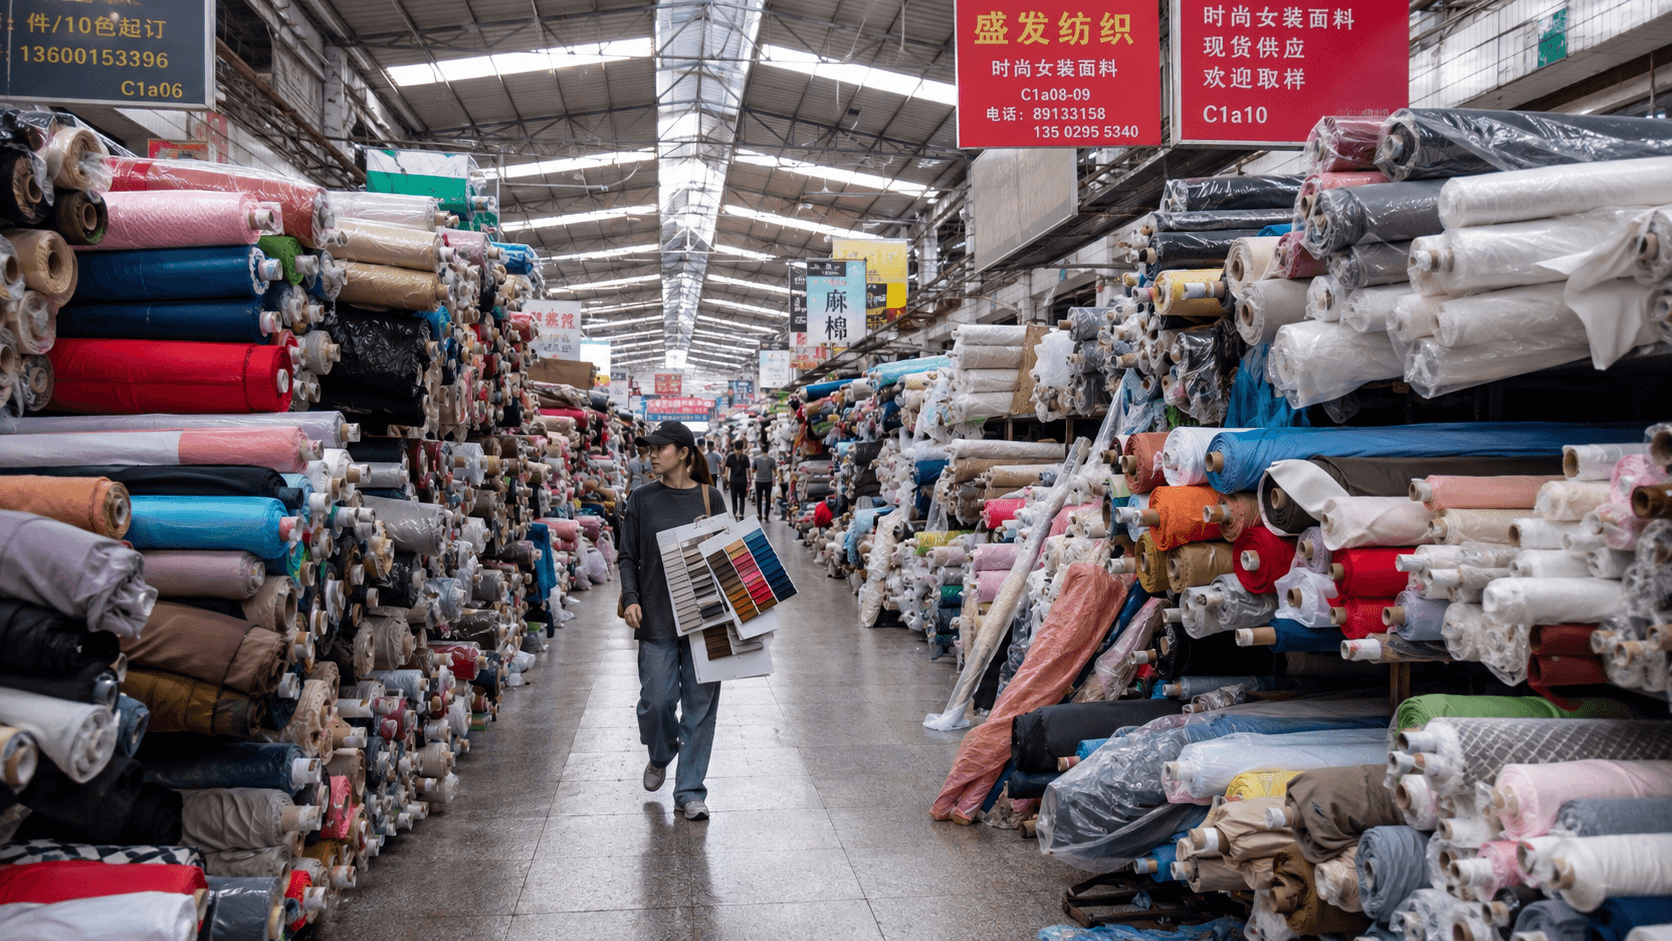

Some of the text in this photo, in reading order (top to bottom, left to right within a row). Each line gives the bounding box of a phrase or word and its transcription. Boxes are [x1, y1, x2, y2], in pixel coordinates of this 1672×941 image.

[1203, 4, 1355, 30] 时尚女装面料
[974, 10, 1134, 45] 盛发纺织
[20, 45, 169, 69] 13600153396
[1203, 35, 1305, 59] 现货供应
[991, 58, 1118, 78] 时尚女装面料
[1203, 66, 1305, 90] 欢迎取样
[121, 80, 183, 98] C1a06
[1021, 88, 1091, 101] C1a08-09
[1033, 107, 1106, 120] 89133158
[1202, 105, 1268, 124] C1a10
[1033, 125, 1139, 138] 135 0295 5340
